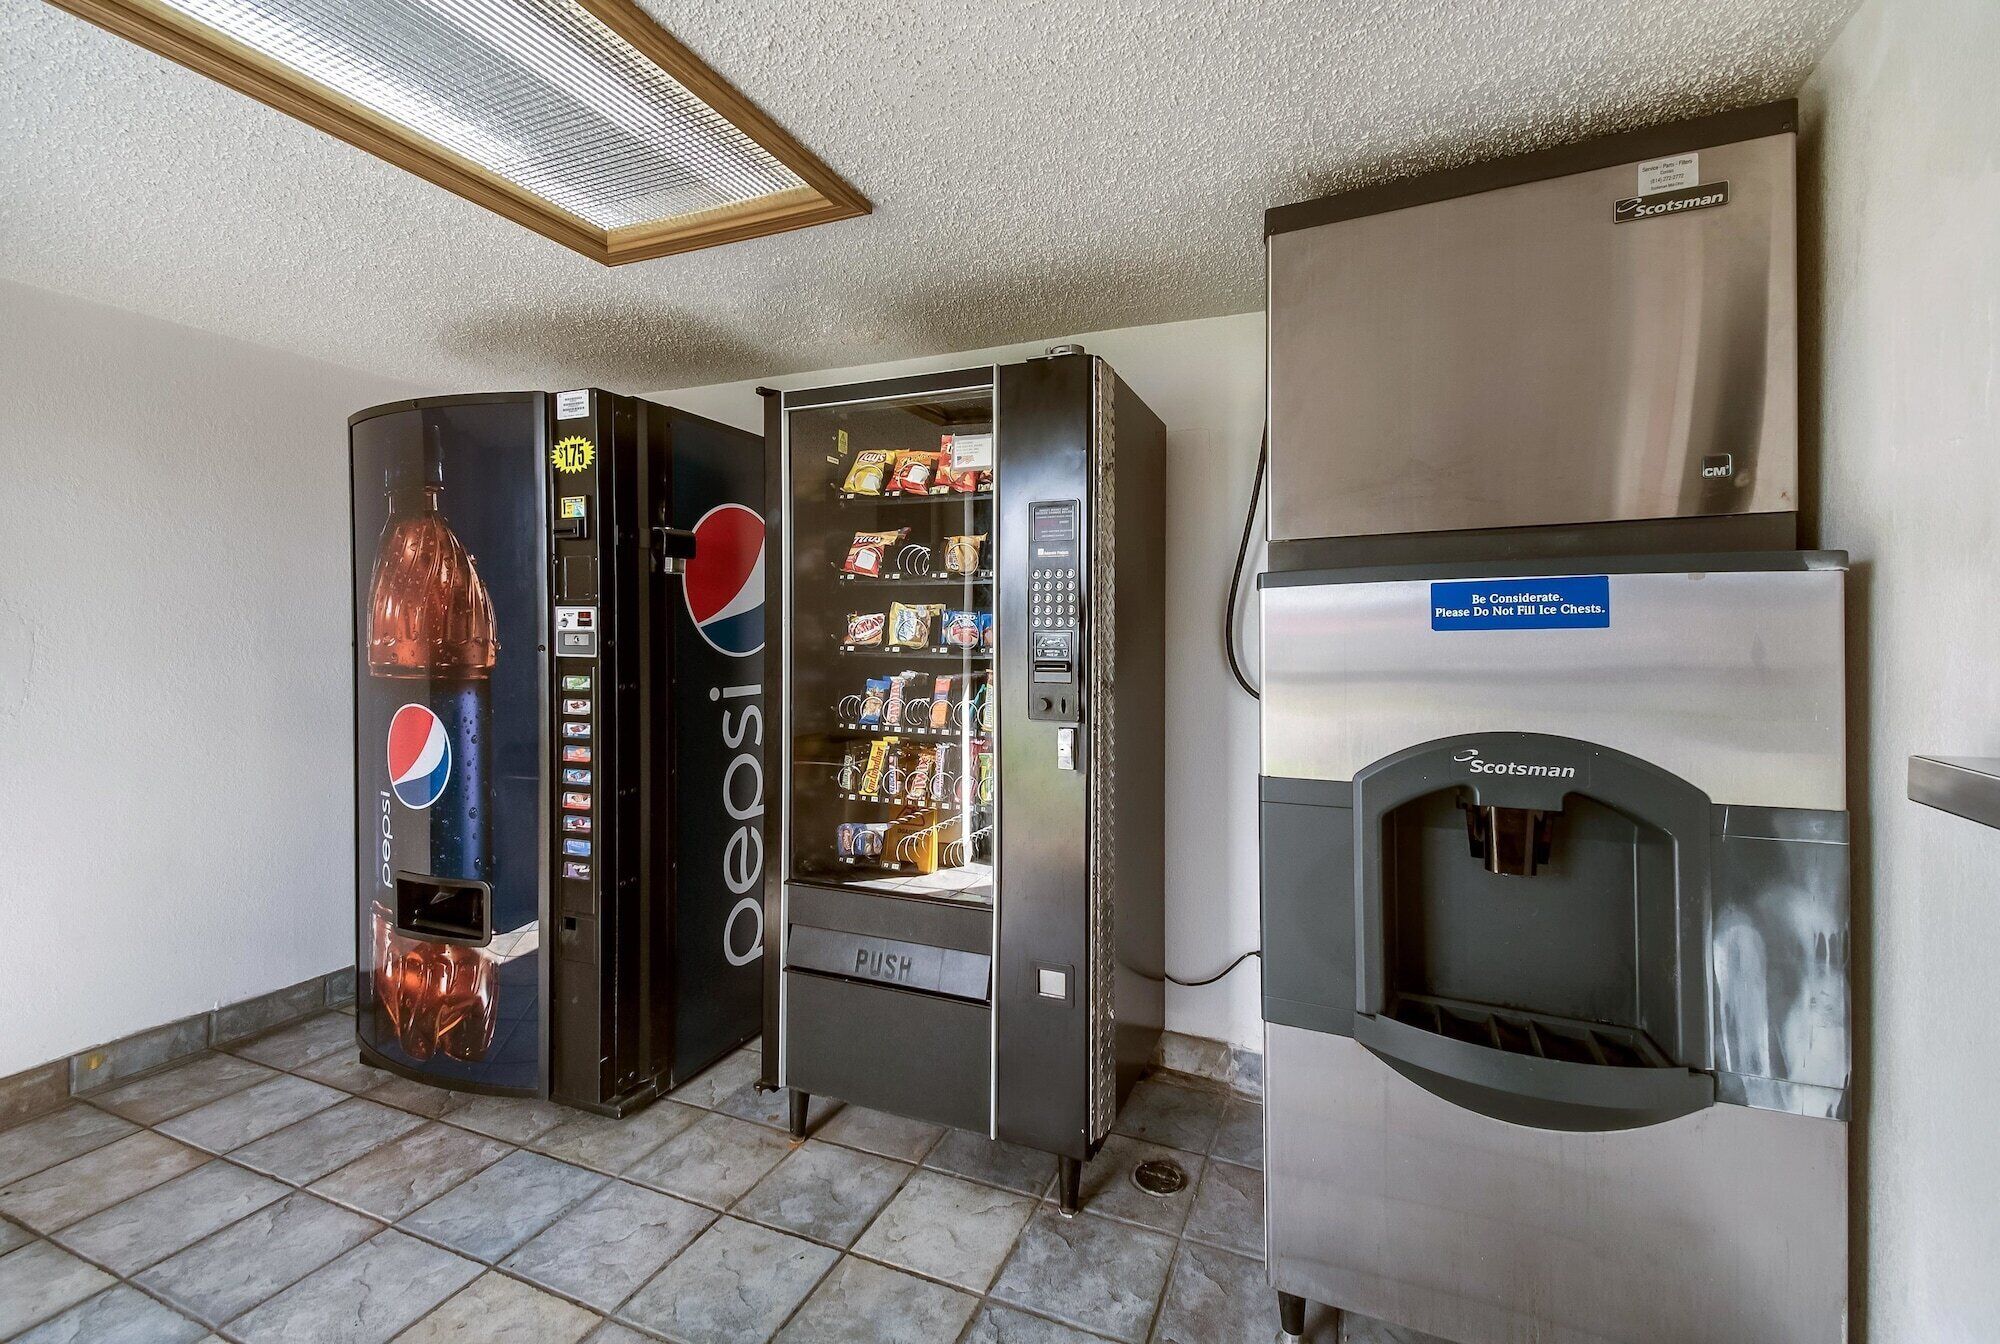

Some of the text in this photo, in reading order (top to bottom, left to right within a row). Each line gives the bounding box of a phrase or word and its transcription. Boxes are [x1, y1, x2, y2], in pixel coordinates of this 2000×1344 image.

[1642, 165, 1659, 173] Service
[1634, 192, 1724, 217] Scotsman
[559, 443, 585, 467] $1.75
[1472, 592, 1564, 604] Be Considerate.
[1435, 603, 1606, 618] Please Do Not Fill Ice Chests.
[1469, 759, 1575, 778] Scotsman
[709, 683, 765, 967] pepsi
[380, 789, 394, 888] pepsi
[854, 948, 912, 981] PUSH
